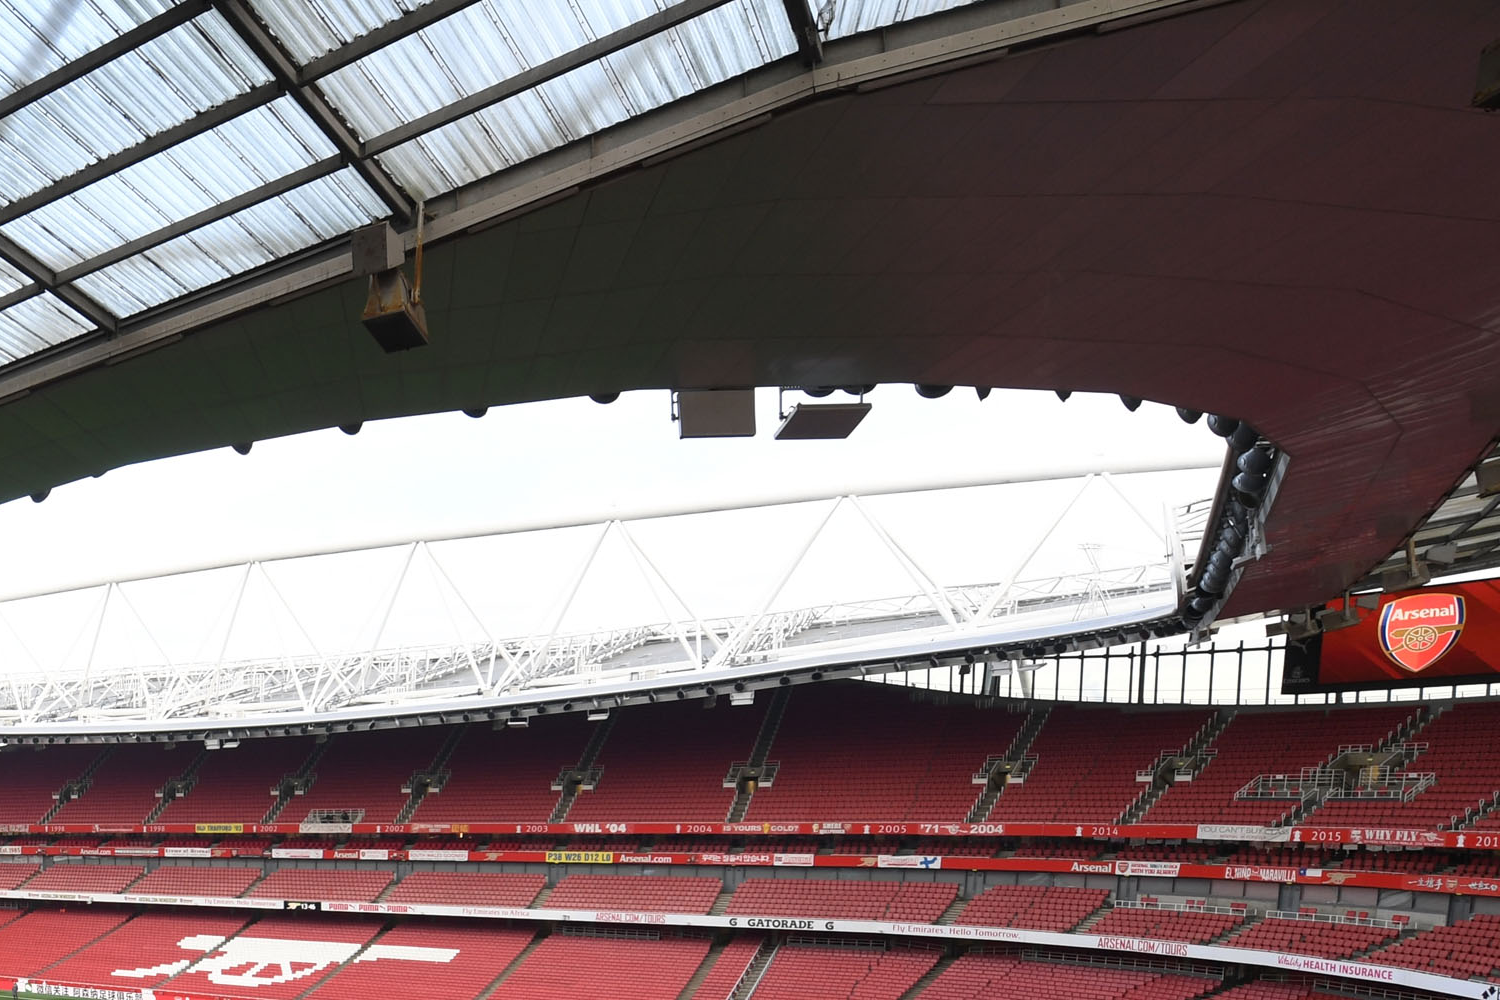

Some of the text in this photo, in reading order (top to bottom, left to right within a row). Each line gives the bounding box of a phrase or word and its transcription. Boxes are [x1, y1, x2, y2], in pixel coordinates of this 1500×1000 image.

[1391, 604, 1454, 622] Arsenal
[574, 824, 626, 832] WHL '04
[879, 825, 907, 833] 2005
[920, 824, 1004, 834] '71 2004
[1092, 827, 1118, 835] 2014
[1311, 831, 1341, 842] 2015
[1365, 830, 1417, 842] WHY FLY
[333, 851, 358, 859] Arsenal
[565, 853, 581, 861] W26
[619, 853, 671, 863] Arsenal.com
[1071, 861, 1112, 873] Arsenal
[1260, 869, 1296, 882] MARAVILLA
[729, 918, 834, 930] G GATORADE G
[892, 924, 905, 933] Fly
[949, 927, 971, 936] Hello
[1097, 937, 1188, 956] ARSENAL.COM/TOURS
[1303, 960, 1336, 972] HEALTH
[1339, 965, 1393, 980] INSURANCE
